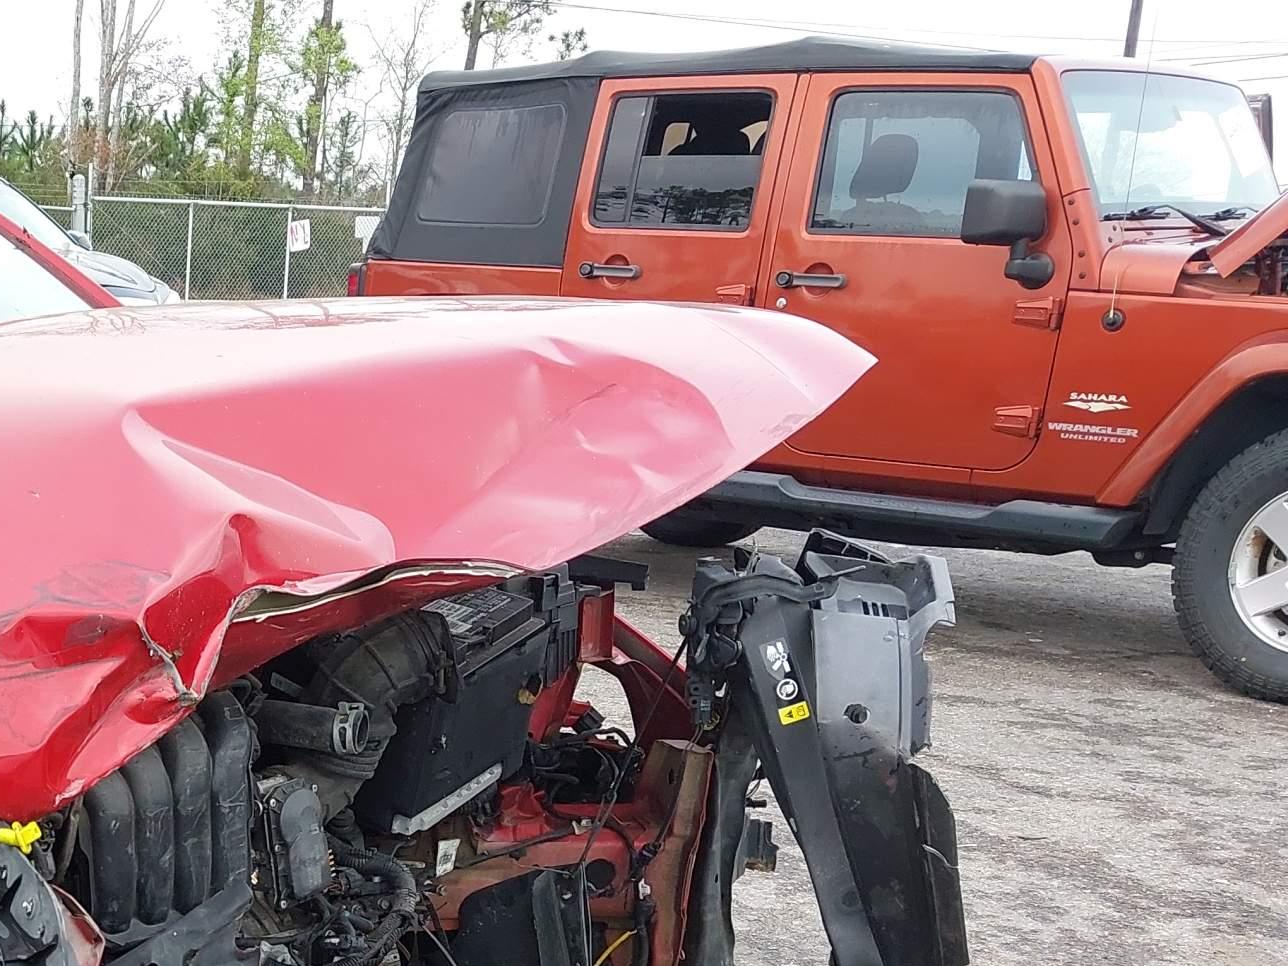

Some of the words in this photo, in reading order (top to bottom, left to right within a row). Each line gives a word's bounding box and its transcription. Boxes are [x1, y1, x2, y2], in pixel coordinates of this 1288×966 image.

[1069, 392, 1129, 403] SAHARA
[1047, 421, 1139, 437] WRANGLER
[1060, 432, 1127, 444] UNLIMITED
